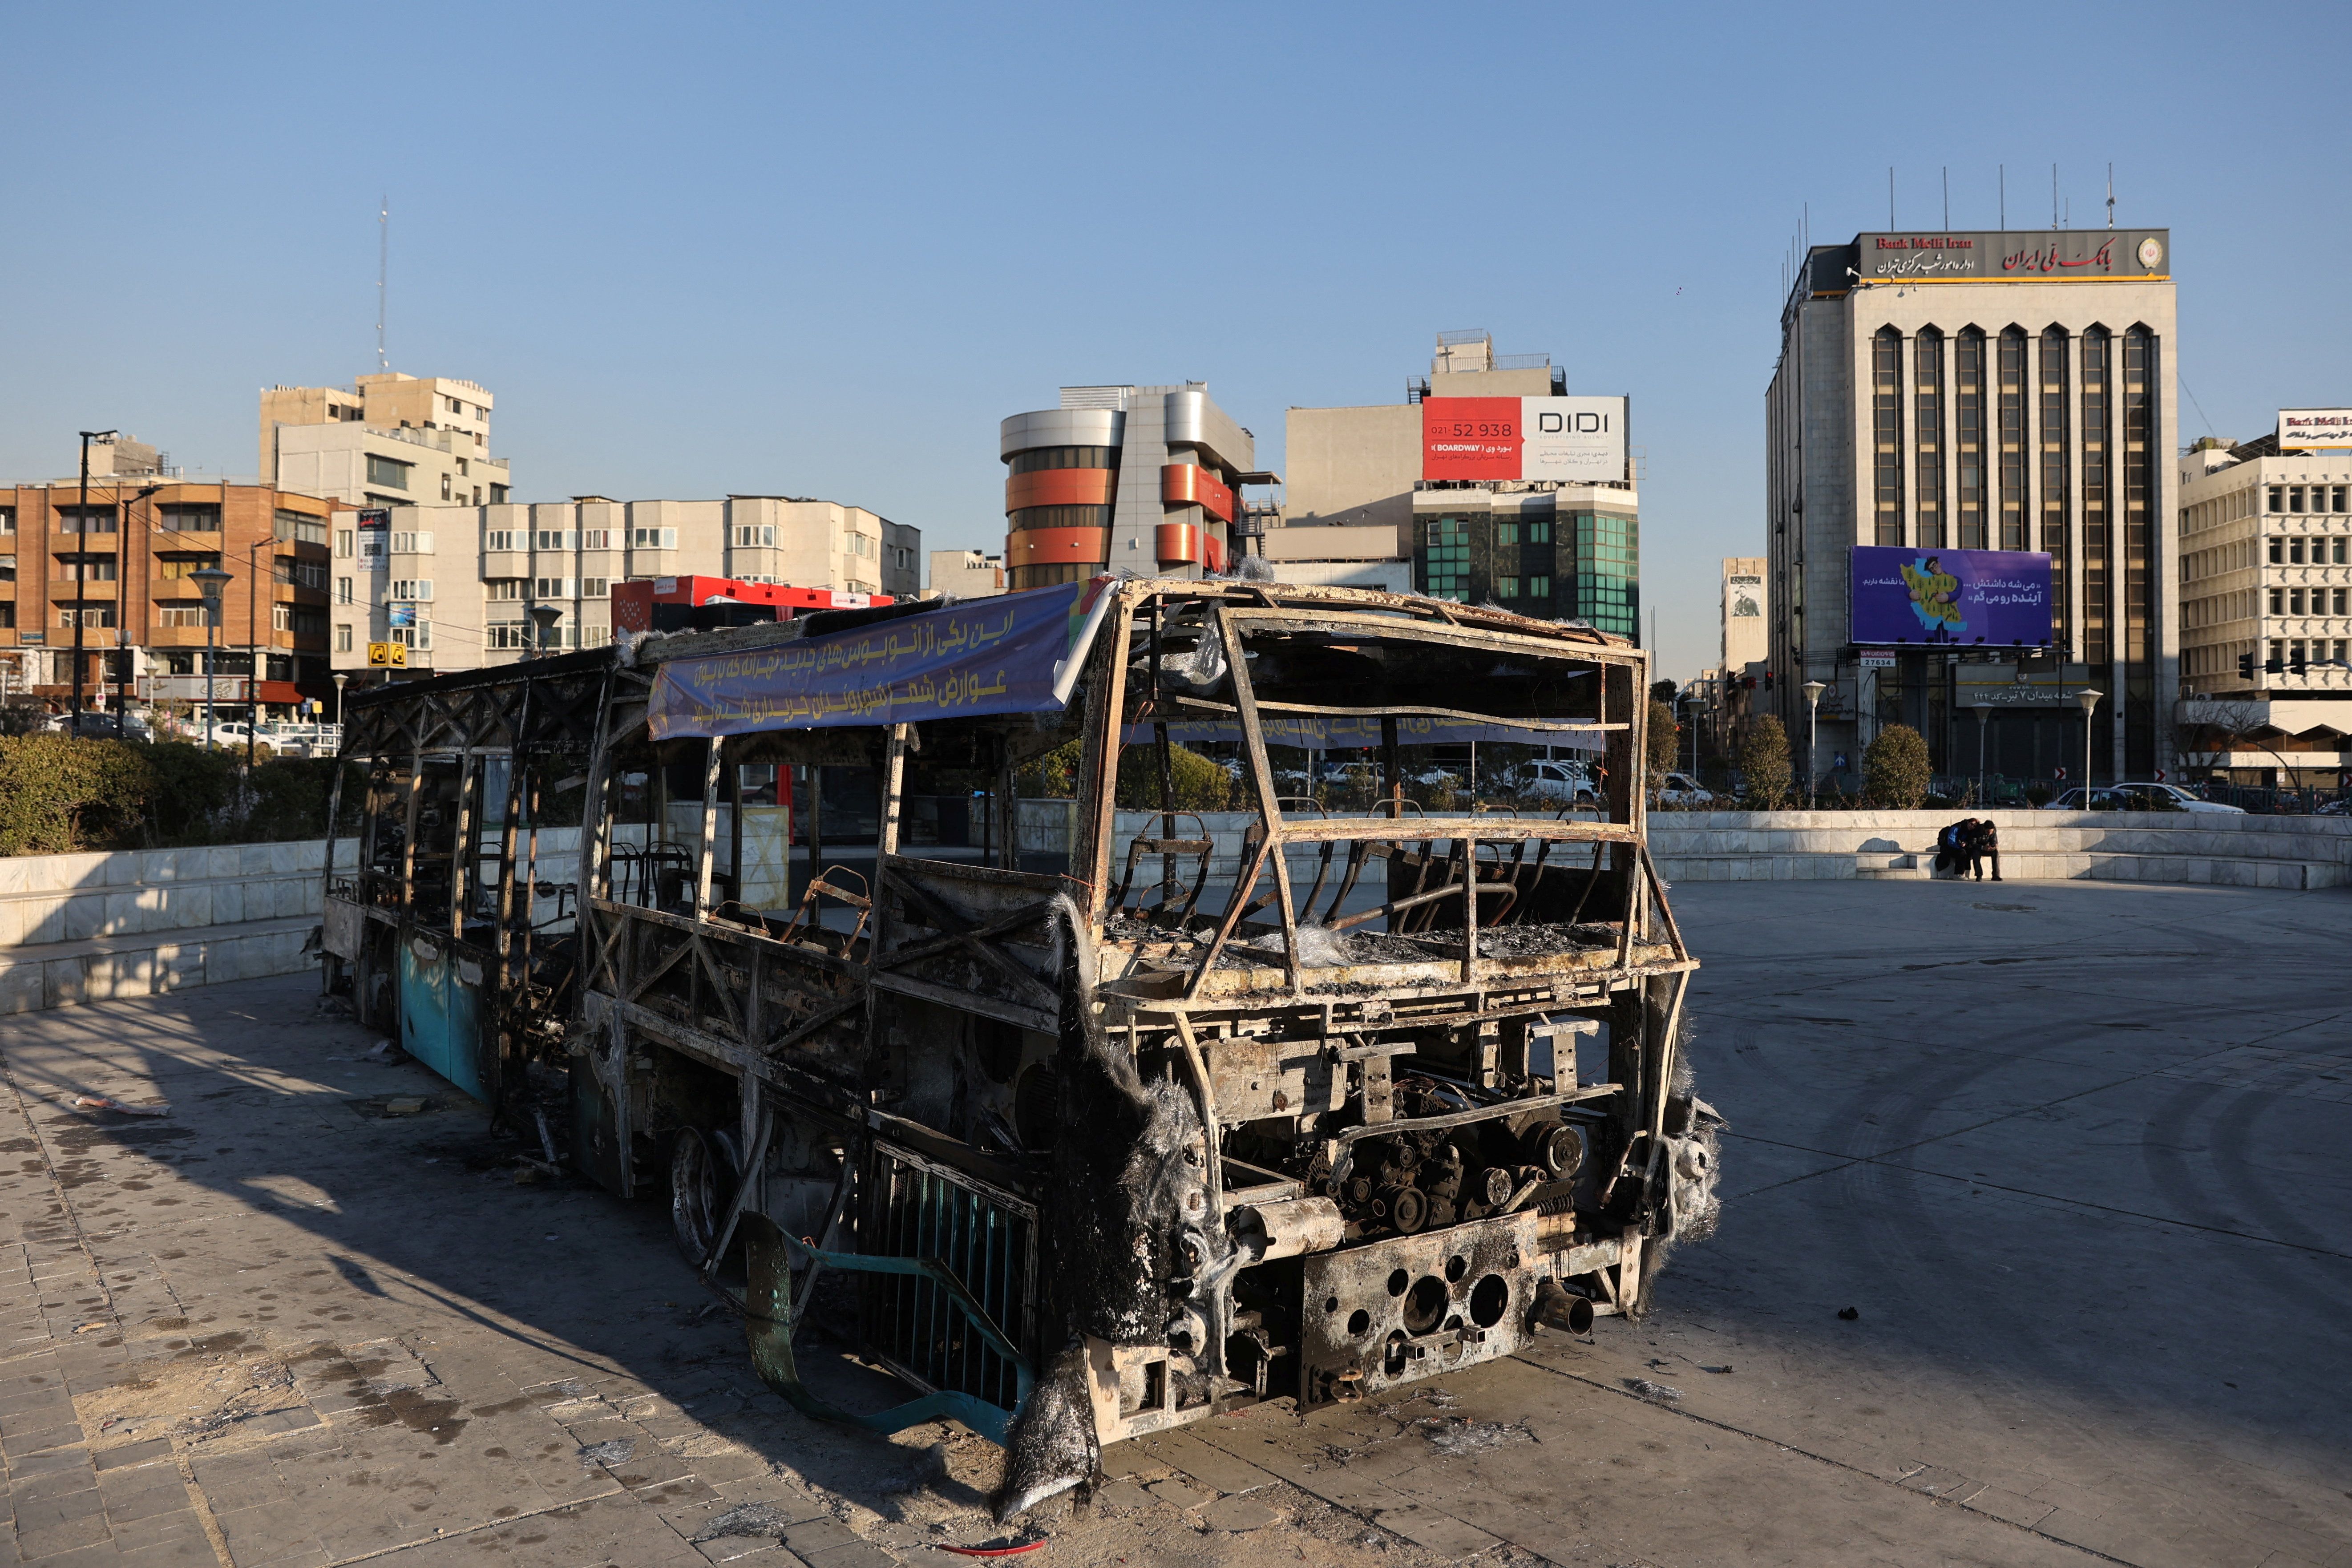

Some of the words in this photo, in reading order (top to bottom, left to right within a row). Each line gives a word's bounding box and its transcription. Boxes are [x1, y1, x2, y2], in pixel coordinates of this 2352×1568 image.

[1877, 238, 1908, 249] Bank
[1912, 237, 1944, 248] Melli
[1946, 237, 1973, 248] Iran
[2058, 236, 2117, 271] بانک
[1877, 258, 1900, 274] تهران
[1896, 251, 1924, 274] مرکزی
[1921, 253, 1942, 275] شعب
[1939, 260, 1956, 270] امور
[1956, 259, 1974, 270] اداره
[2003, 249, 2040, 270] ایران
[1453, 424, 1473, 436] 52
[1479, 424, 1512, 436] 938
[1540, 413, 1608, 432] DIDI
[2286, 417, 2313, 426] Bank
[2315, 417, 2342, 425] Melli
[1496, 445, 1512, 453] بورد
[1972, 578, 2007, 590] داشتش
[2000, 595, 2010, 605] رو
[2011, 591, 2042, 606] آینده
[922, 622, 934, 658] از
[937, 618, 968, 657] یکی
[969, 609, 1014, 650] این
[717, 659, 726, 687] با
[726, 655, 740, 678] که
[741, 648, 779, 681] تهرانه
[779, 647, 816, 677] جدید
[694, 661, 718, 690] پول
[889, 674, 935, 705] شما
[938, 669, 1007, 708] عوارض
[2027, 691, 2053, 702] میدان
[2053, 690, 2073, 700] شعه
[715, 695, 751, 720] شده
[752, 687, 810, 724] خریداری
[812, 681, 889, 720] شهروندان
